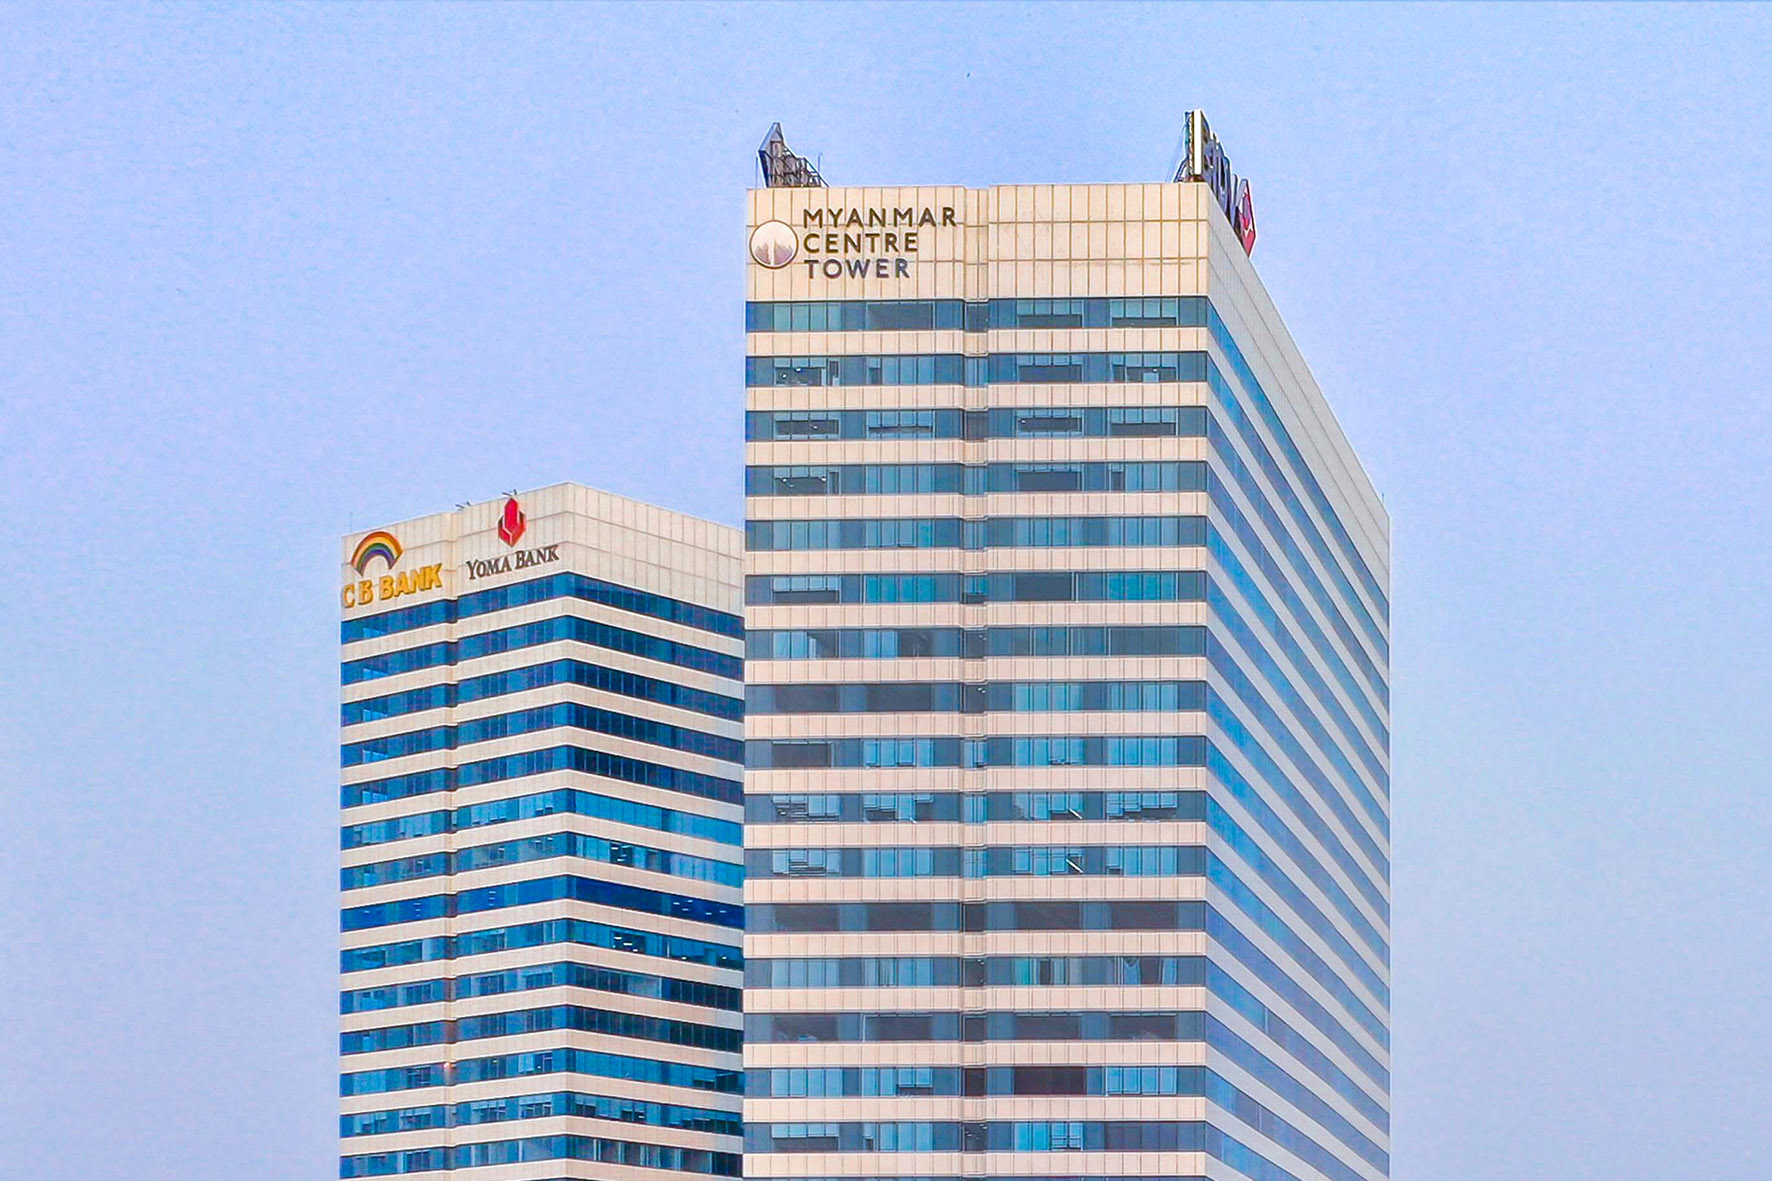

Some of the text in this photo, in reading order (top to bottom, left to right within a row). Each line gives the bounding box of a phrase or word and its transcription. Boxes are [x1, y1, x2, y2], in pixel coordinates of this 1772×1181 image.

[803, 207, 957, 229] MYANMAR
[803, 232, 918, 254] CENTRE
[804, 258, 910, 279] TOWER
[465, 544, 560, 580] YOMA BANK
[379, 563, 443, 600] BANK
